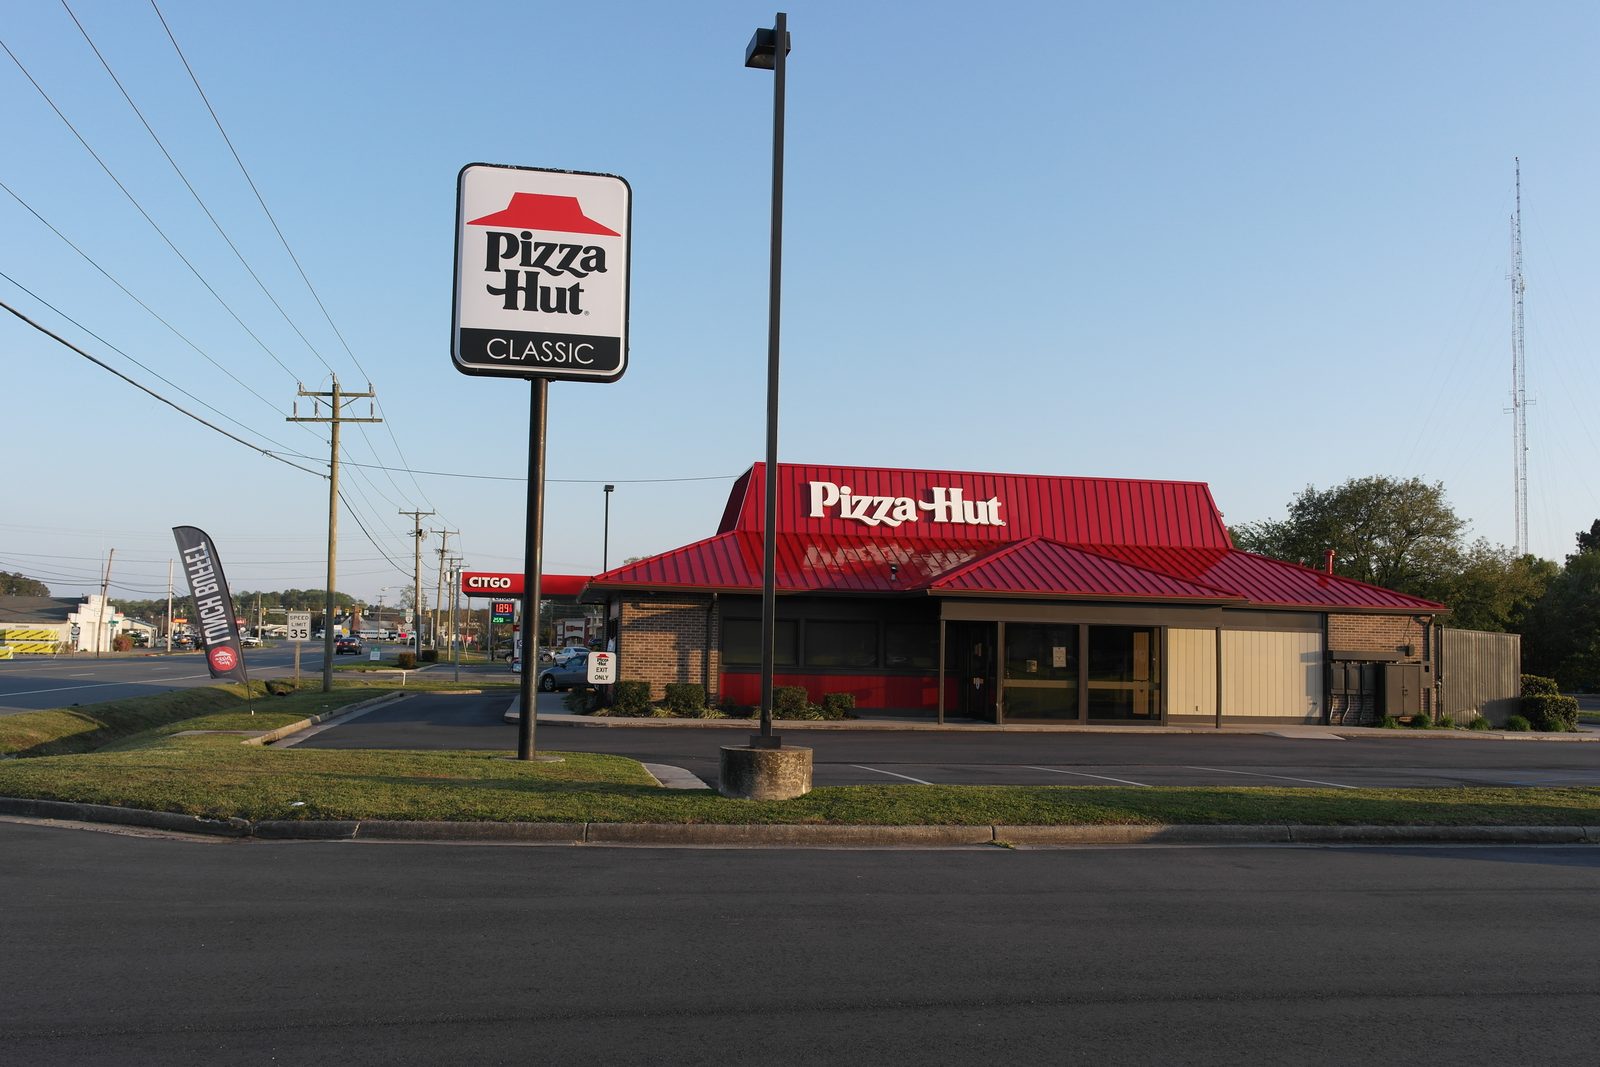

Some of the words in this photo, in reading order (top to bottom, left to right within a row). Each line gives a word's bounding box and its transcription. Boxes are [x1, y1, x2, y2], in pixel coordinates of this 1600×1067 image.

[484, 231, 608, 278] Pizza
[486, 269, 586, 316] Hut
[486, 338, 595, 365] CLASSIC
[809, 481, 918, 527] Pizza
[918, 486, 1006, 527] Hut
[469, 576, 511, 588] CITGO
[290, 629, 308, 639] 35
